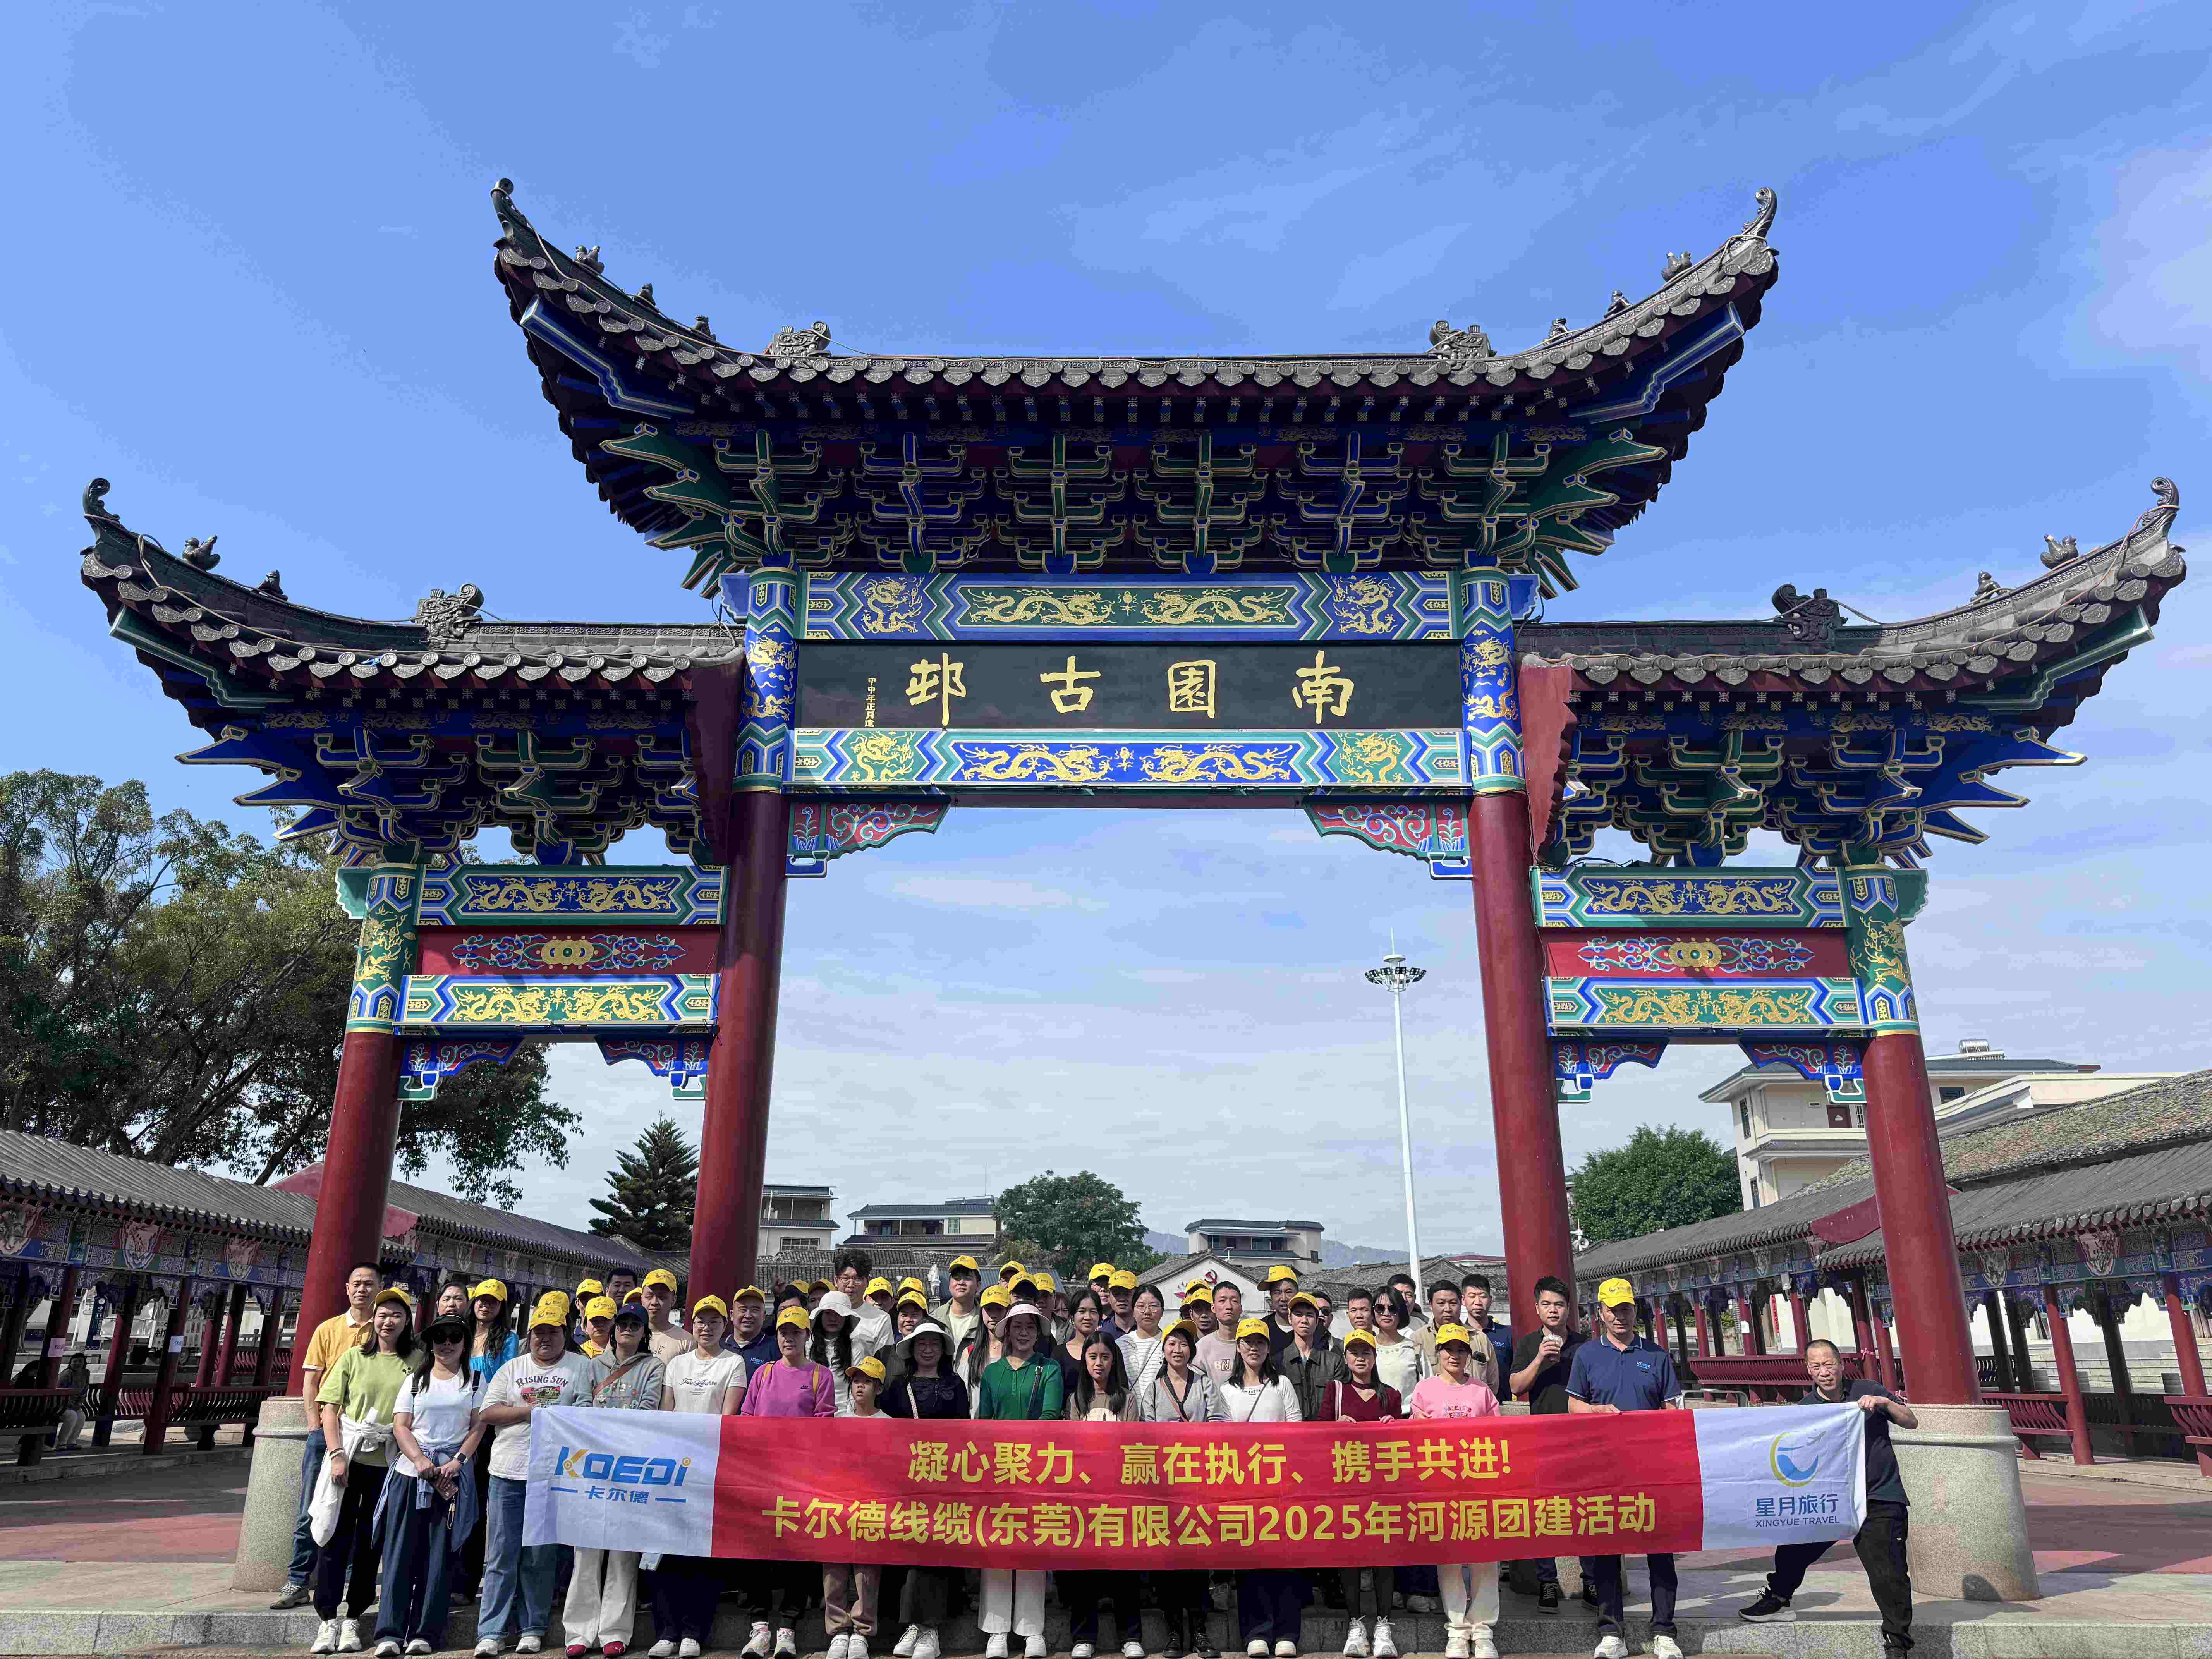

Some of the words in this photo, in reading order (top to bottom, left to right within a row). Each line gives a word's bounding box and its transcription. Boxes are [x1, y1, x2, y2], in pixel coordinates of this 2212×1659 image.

[515, 1376, 548, 1388] RISING
[550, 1375, 568, 1387] SUN
[584, 1486, 650, 1504] 卡尔德
[1755, 1493, 1839, 1517] 星月旅行
[1755, 1518, 1800, 1527] XINGYUE
[1803, 1516, 1840, 1525] TRAVEL
